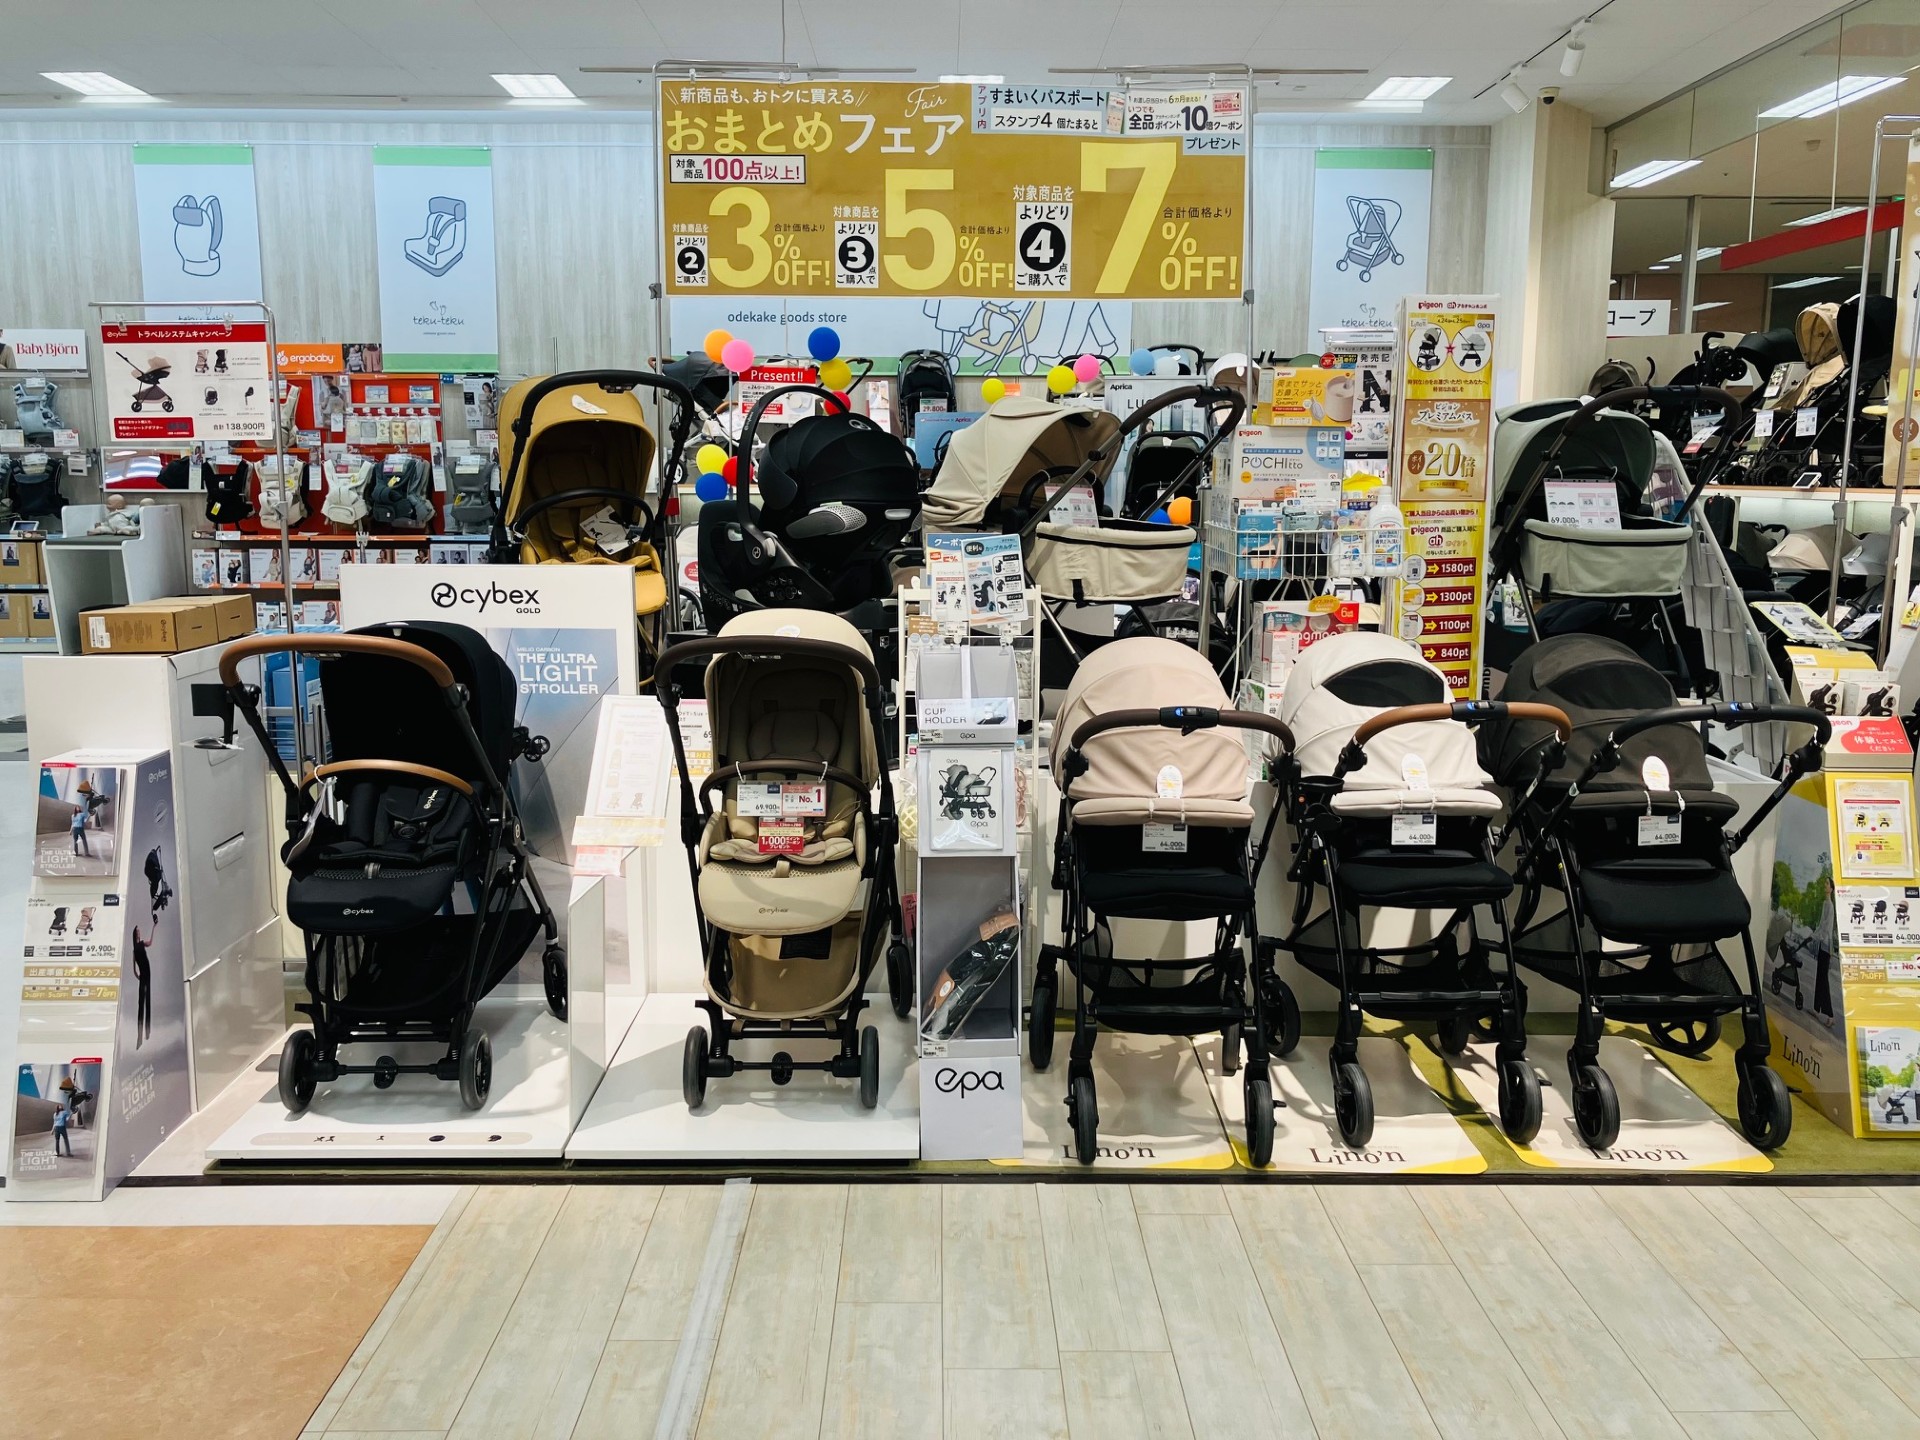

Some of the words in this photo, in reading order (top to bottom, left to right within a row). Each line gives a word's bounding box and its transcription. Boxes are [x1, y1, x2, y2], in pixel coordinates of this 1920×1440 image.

[680, 87, 855, 105] 新商品も、おトクに買える
[904, 84, 947, 118] Fair
[990, 88, 1105, 107] すまいくパスポート
[977, 85, 987, 129] アプリ内
[995, 112, 1098, 130] スタンプ4個たまると
[666, 108, 965, 156] おまとめフェア
[1186, 137, 1240, 150] プレゼント
[676, 158, 696, 168] 対象
[703, 158, 800, 180] 100点以上!
[684, 169, 704, 179] 商品
[1013, 185, 1075, 201] 対象商品を
[833, 206, 880, 219] 対象商品を
[1020, 204, 1069, 220] よりどり
[1080, 142, 1177, 294] 7
[1163, 207, 1232, 219] 合計価格より
[672, 223, 709, 233] 対象商品を
[774, 223, 826, 232] 合計価格より
[837, 223, 876, 235] よりどり
[883, 169, 956, 291] 5
[960, 225, 1010, 235] 合計価格より
[676, 237, 706, 246] よりどり
[708, 186, 772, 288] 3
[1027, 228, 1054, 264] 4
[684, 252, 699, 269] 2
[846, 240, 868, 269] 3
[774, 260, 830, 286] OFF!
[868, 267, 877, 275] 点
[1058, 263, 1068, 273] 点
[1160, 256, 1237, 291] OFF!
[676, 275, 706, 284] ご購入で
[836, 274, 876, 285] ご購入で
[959, 262, 1013, 288] OFF!
[1016, 273, 1066, 287] ご購入で
[1418, 301, 1443, 309] pigeon
[413, 316, 465, 325] teku-teku
[727, 311, 777, 323] odekake
[780, 311, 815, 325] goods
[818, 312, 847, 323] store
[1341, 317, 1393, 328] teku-teku
[137, 330, 232, 339] トラベルシステムキャンペーン
[16, 343, 79, 356] BabyBjörn
[290, 354, 335, 364] ergobaby
[751, 369, 804, 382] Present!!
[1435, 403, 1459, 411] ピジョン
[1419, 411, 1472, 421] プレミアムパス
[1239, 429, 1262, 437] pigeon
[1411, 526, 1439, 535] pigeon
[934, 538, 961, 547] クーポ
[1441, 563, 1473, 574] 1580pt
[460, 581, 540, 612] cybex
[1440, 592, 1472, 602] 1300pt
[1439, 620, 1470, 631] 1100pt
[517, 653, 546, 664] THE
[550, 653, 597, 664] ULTRA
[1441, 648, 1469, 659] 840pt
[520, 664, 598, 682] LIGHT
[520, 683, 599, 694] STROLLER
[925, 716, 966, 724] HOLDER
[1870, 1040, 1901, 1052] Lino'n
[935, 1067, 1004, 1099] epa
[1063, 1145, 1156, 1160] Lno'n
[1309, 1147, 1407, 1165] Lino'n
